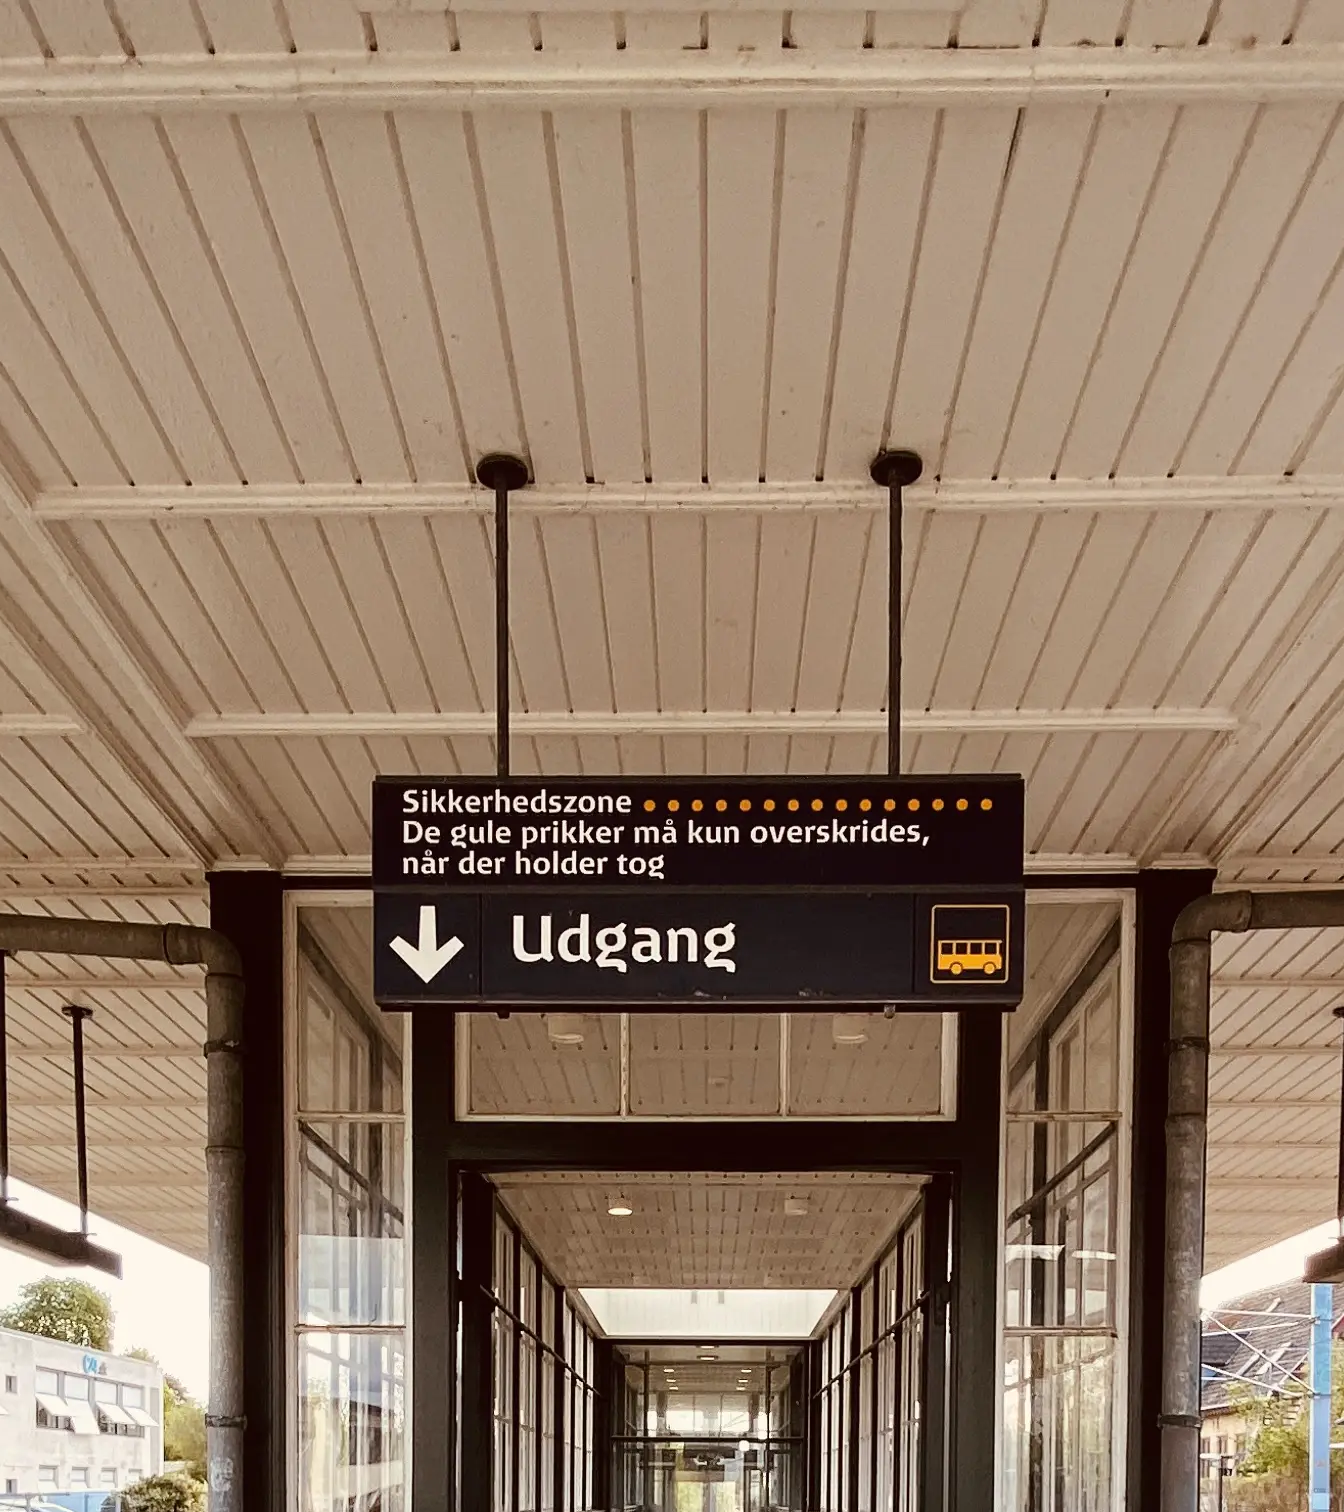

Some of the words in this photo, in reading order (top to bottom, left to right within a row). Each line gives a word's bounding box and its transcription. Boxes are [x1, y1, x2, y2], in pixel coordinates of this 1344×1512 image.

[402, 788, 632, 814] Sikkerhedszone
[403, 821, 441, 845] De
[451, 820, 512, 849] gule
[521, 820, 625, 850] prikker
[633, 818, 678, 844] må
[688, 819, 740, 844] kun
[750, 819, 930, 847] overskrides,
[402, 847, 449, 875] når
[459, 850, 506, 875] der
[515, 848, 609, 875] holder
[617, 854, 665, 880] tog
[512, 913, 736, 973] Udgang
